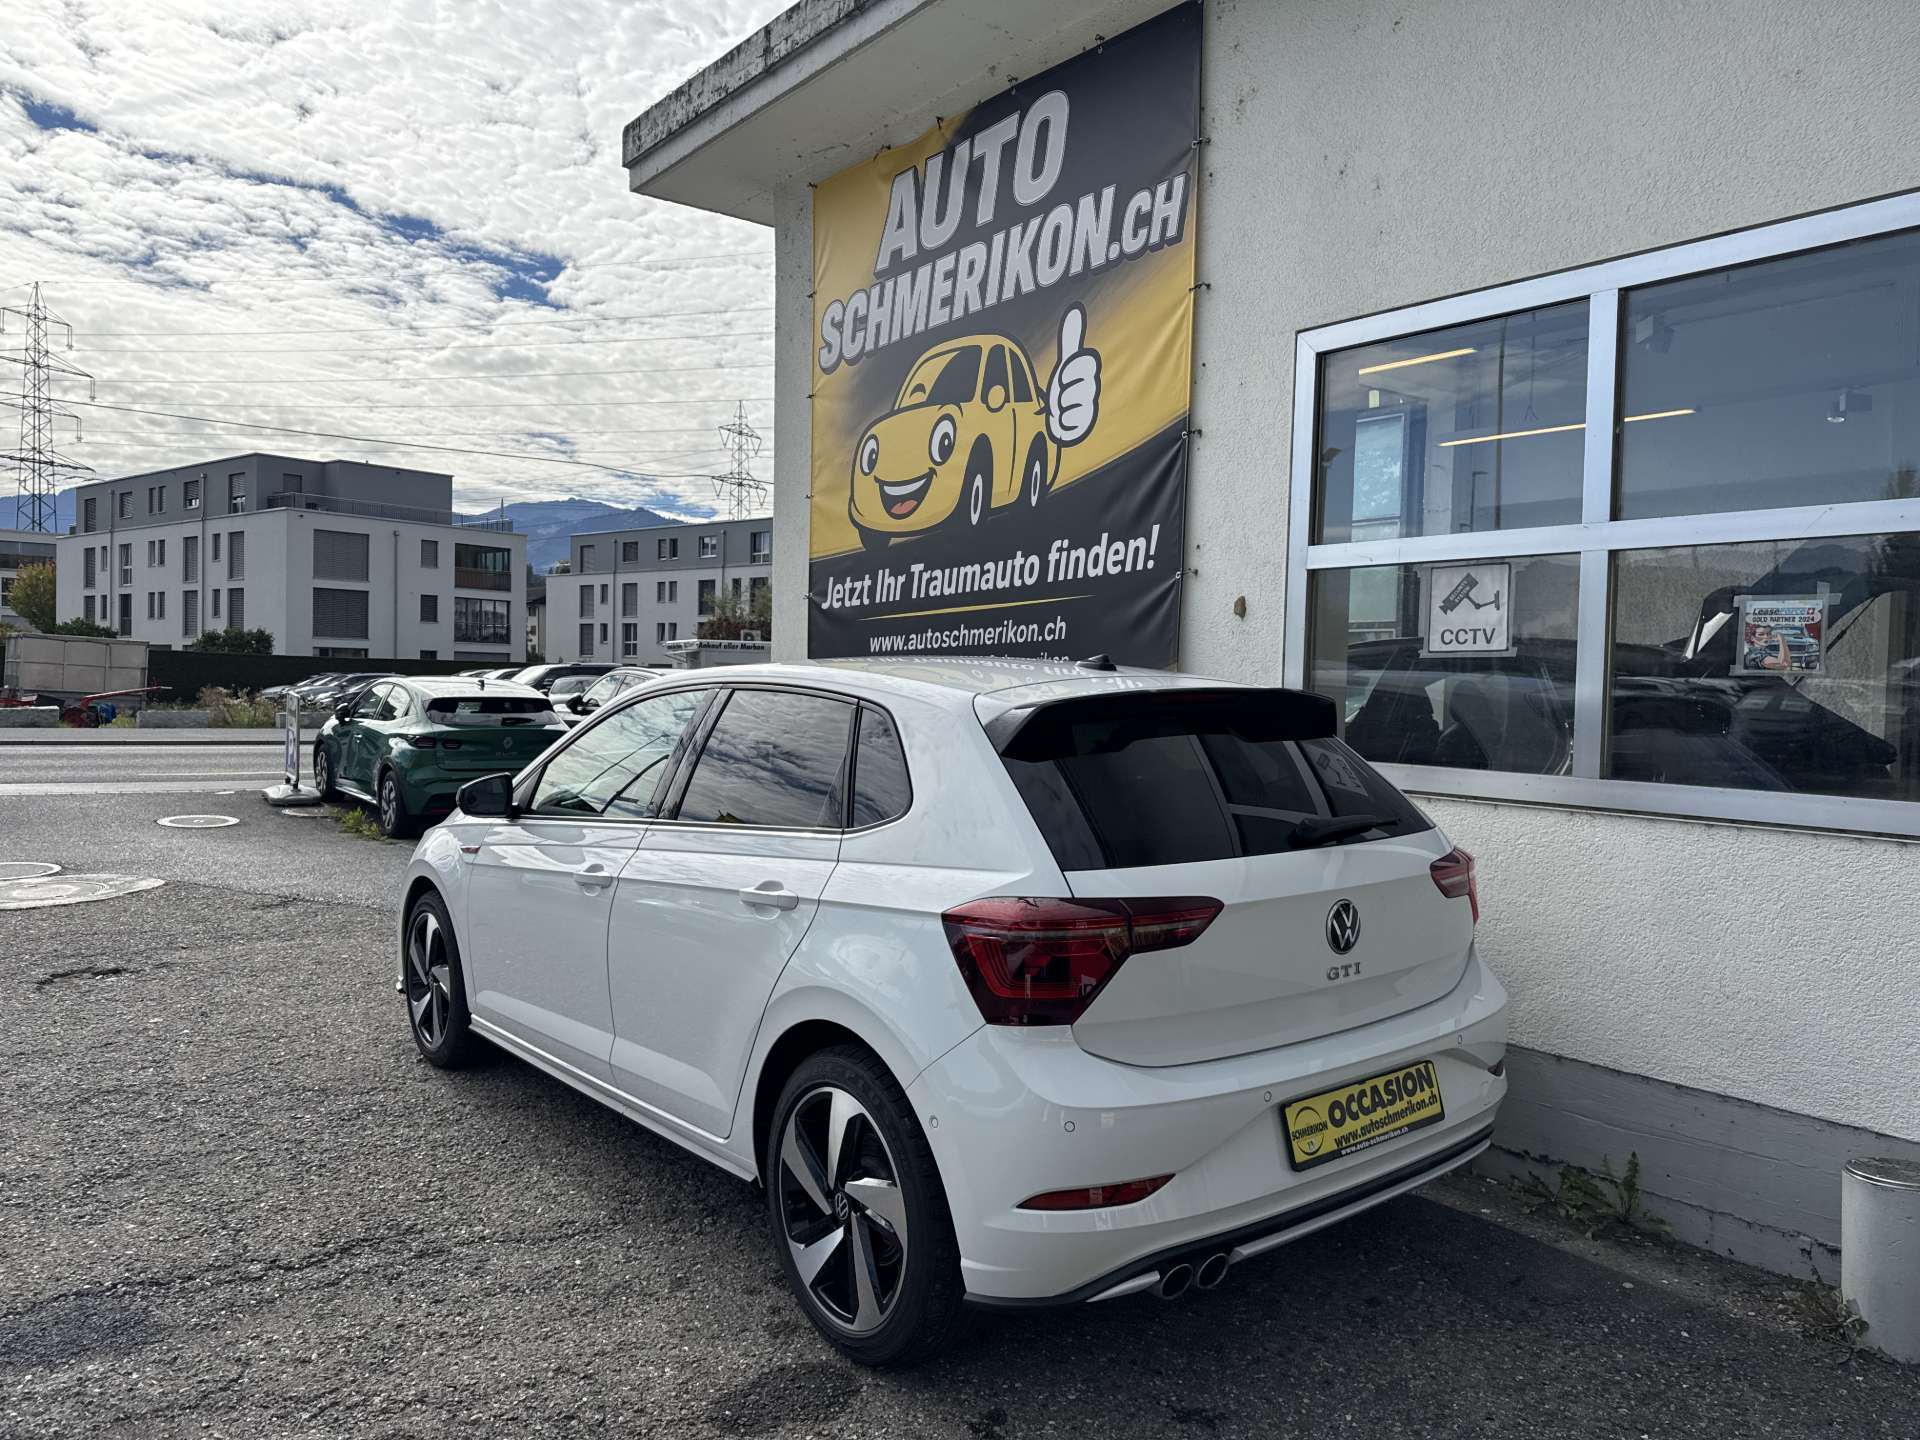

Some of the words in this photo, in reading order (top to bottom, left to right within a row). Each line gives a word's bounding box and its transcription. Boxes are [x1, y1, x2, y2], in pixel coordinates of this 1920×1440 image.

[875, 90, 1069, 273] AUTO
[819, 174, 1187, 371] SCHMERIKON.CH
[820, 576, 870, 610] Jetzt
[876, 567, 904, 602] Ihr
[911, 554, 1039, 598] Traumauto
[1048, 524, 1160, 582] finden!
[870, 616, 1067, 653] www.autoschmerikon.ch
[1440, 628, 1496, 645] CCTV
[1327, 962, 1361, 980] GTI
[1328, 1067, 1434, 1128] OCCASION
[1335, 1092, 1438, 1148] www.autoschmerikon.ch
